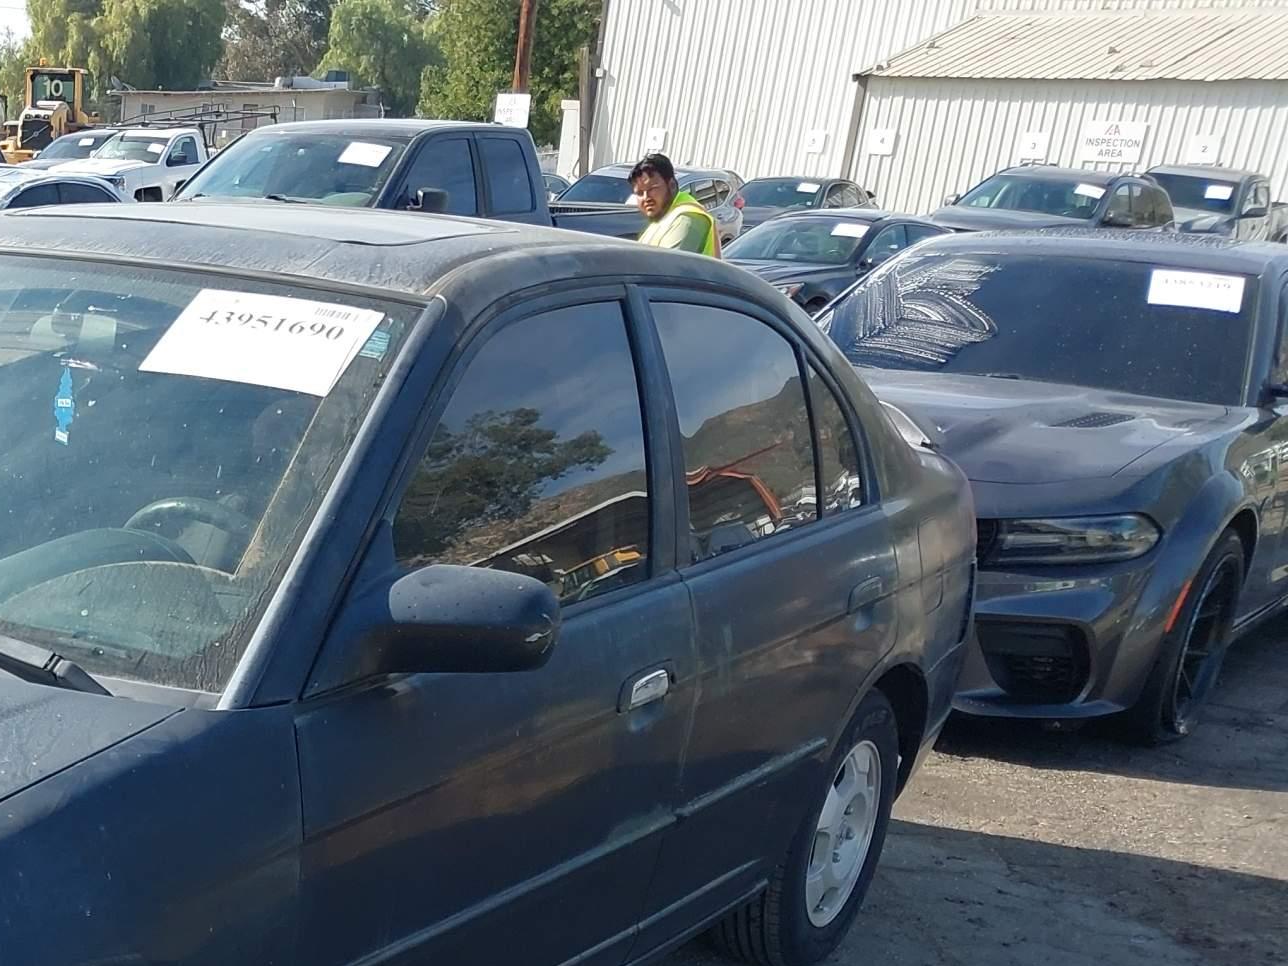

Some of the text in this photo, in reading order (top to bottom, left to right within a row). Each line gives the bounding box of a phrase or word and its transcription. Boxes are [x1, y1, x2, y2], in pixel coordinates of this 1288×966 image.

[43, 79, 63, 97] 10
[1085, 137, 1141, 148] INSPECTION
[1097, 148, 1123, 158] AREA
[198, 308, 346, 342] 43951690
